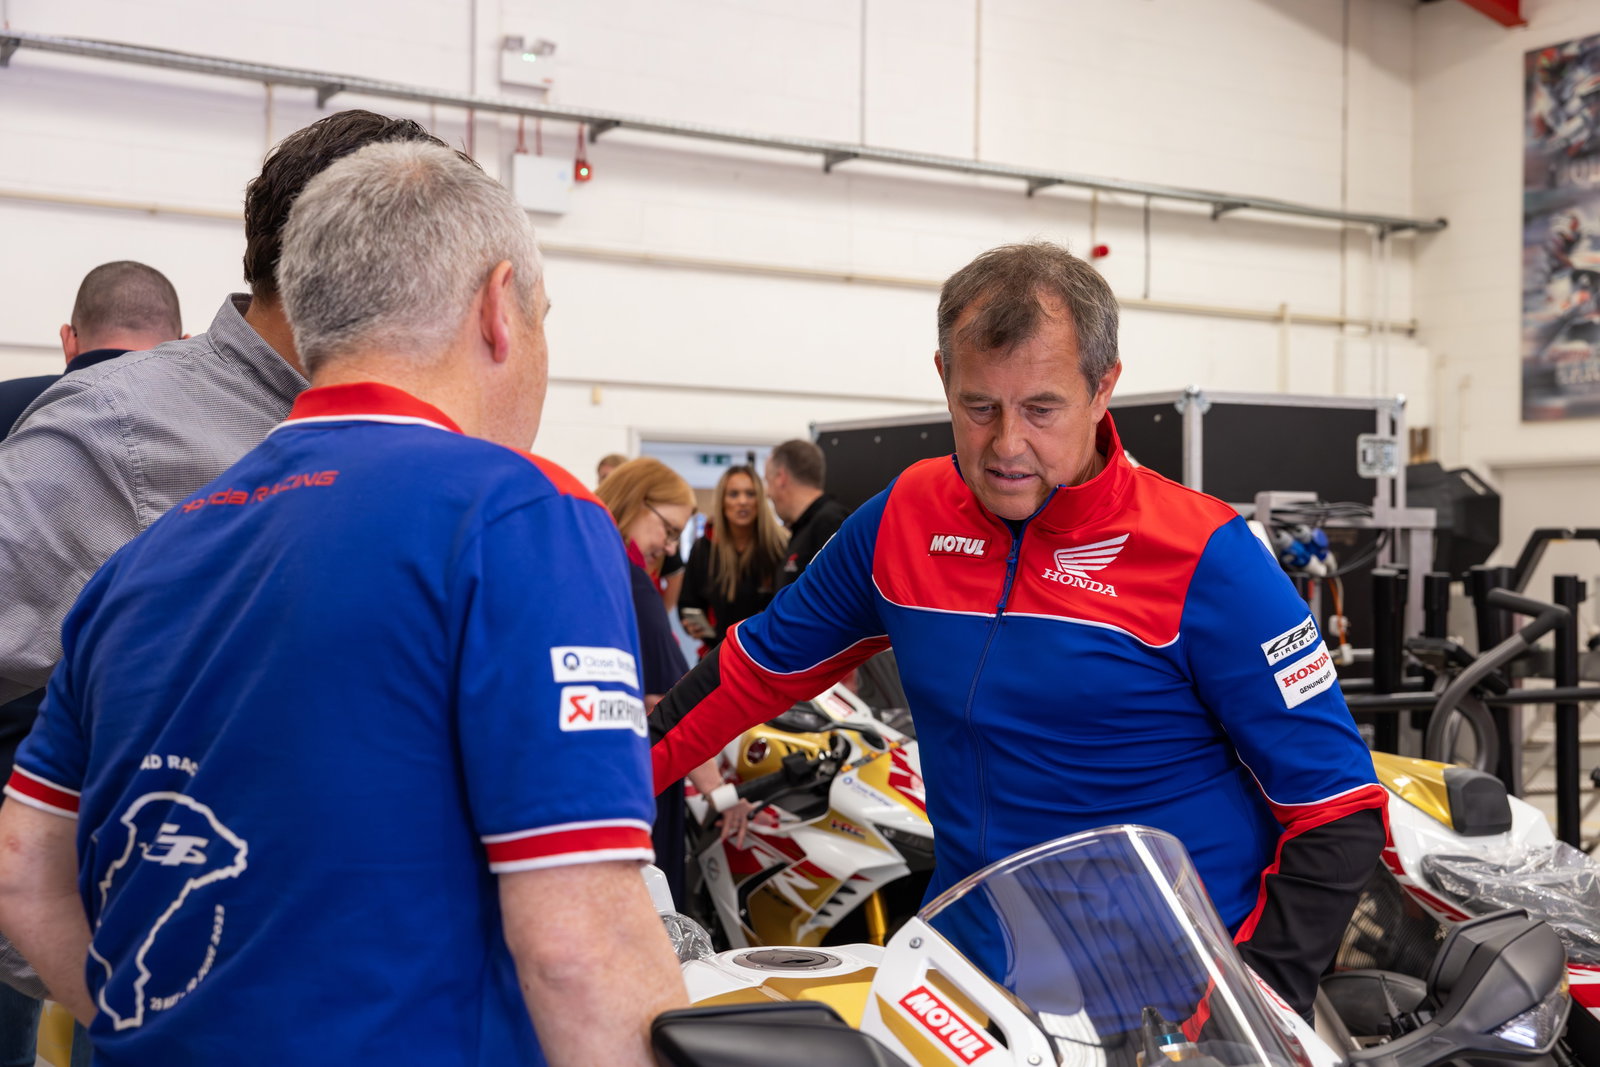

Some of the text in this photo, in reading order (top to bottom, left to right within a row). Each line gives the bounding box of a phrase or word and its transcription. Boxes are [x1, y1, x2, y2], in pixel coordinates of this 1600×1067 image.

[930, 535, 985, 556] MOTUL
[1042, 568, 1118, 597] HONDA
[1267, 620, 1315, 656] CBR
[1282, 652, 1329, 687] HONDA
[1299, 677, 1325, 694] GENUINE
[905, 992, 985, 1060] MOTUL
